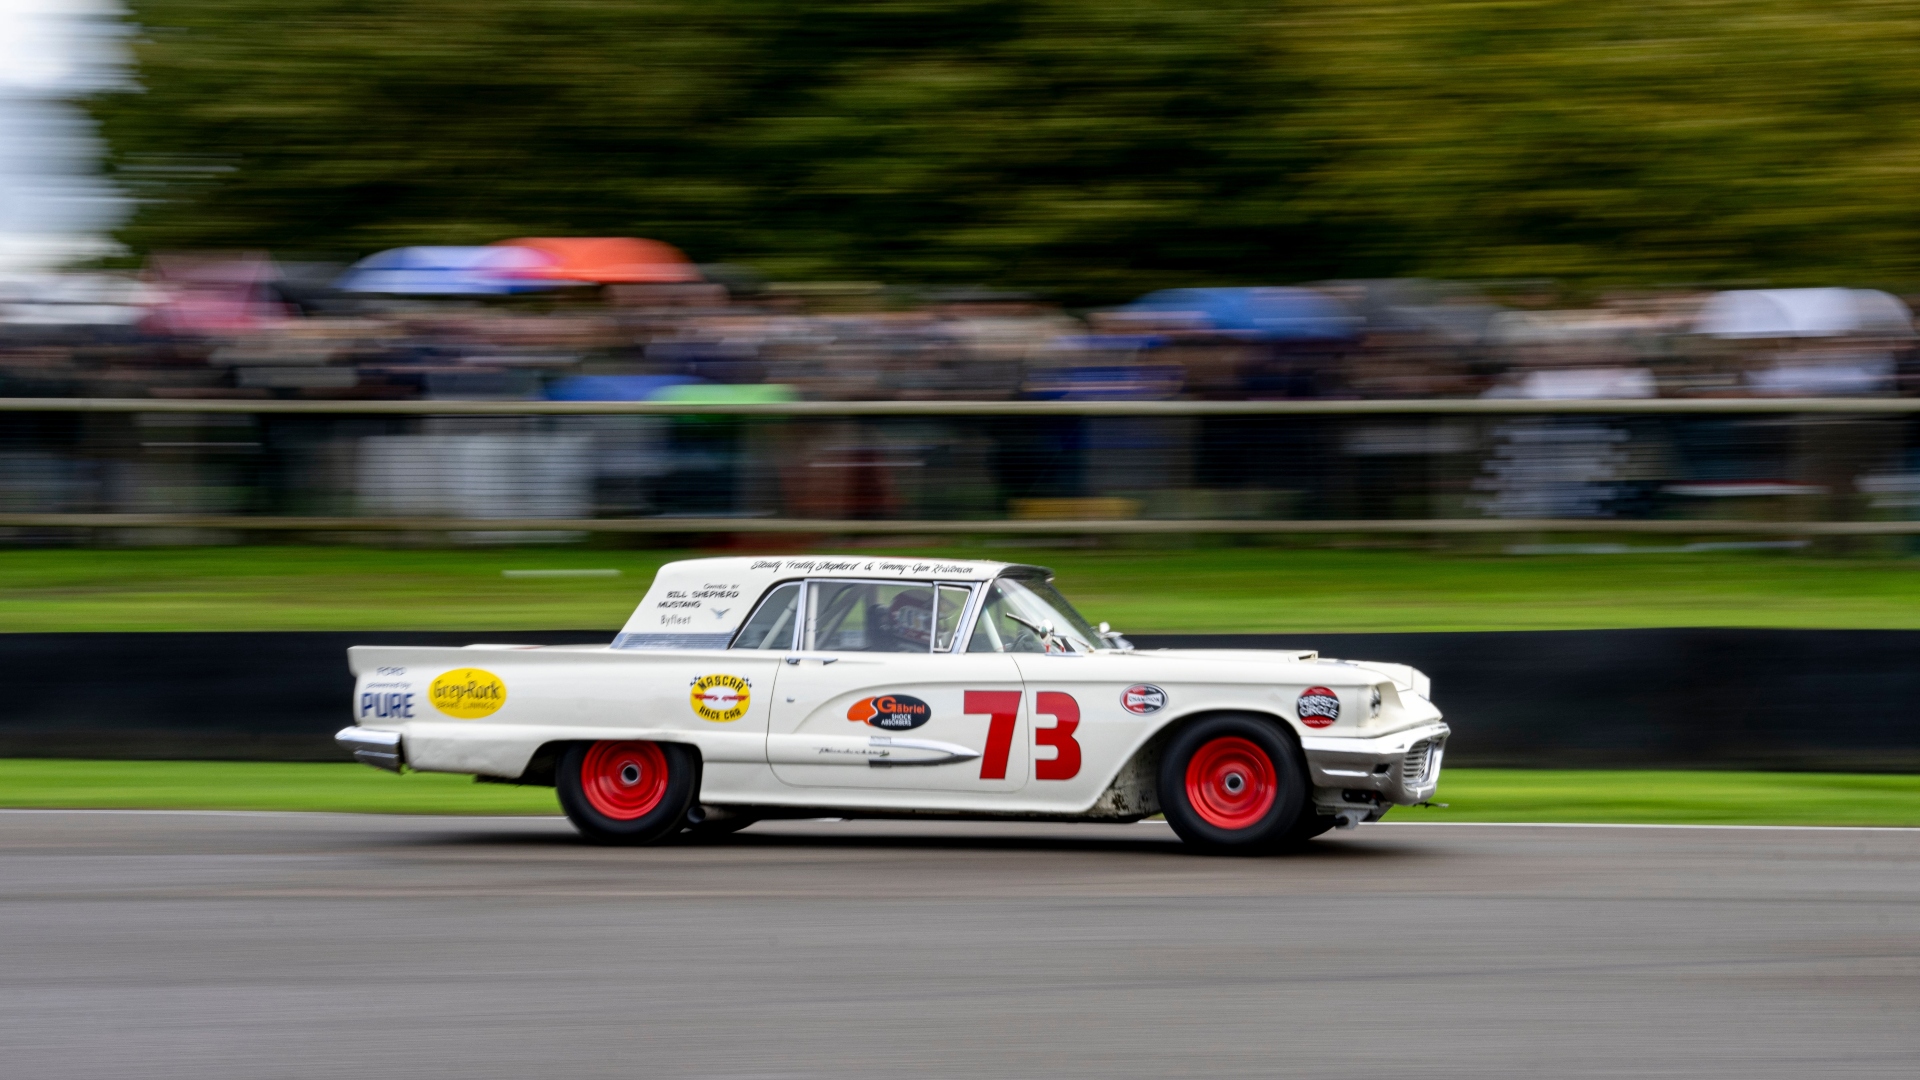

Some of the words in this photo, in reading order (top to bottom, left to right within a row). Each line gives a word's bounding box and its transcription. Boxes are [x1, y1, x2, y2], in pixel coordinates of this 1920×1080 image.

[666, 591, 688, 599] BILL
[692, 590, 740, 599] SHEPHERD
[657, 600, 702, 609] MUSTANG
[660, 614, 692, 627] Byfleet
[698, 675, 744, 693] NASCAR
[361, 692, 416, 719] PURE
[1298, 695, 1339, 709] PERFECT
[699, 705, 720, 720] RACE
[724, 708, 741, 720] CAR
[892, 713, 911, 721] SHOCK
[1300, 705, 1338, 719] CIRCLE
[881, 719, 912, 727] ABSORBERS
[963, 689, 1082, 781] 73
